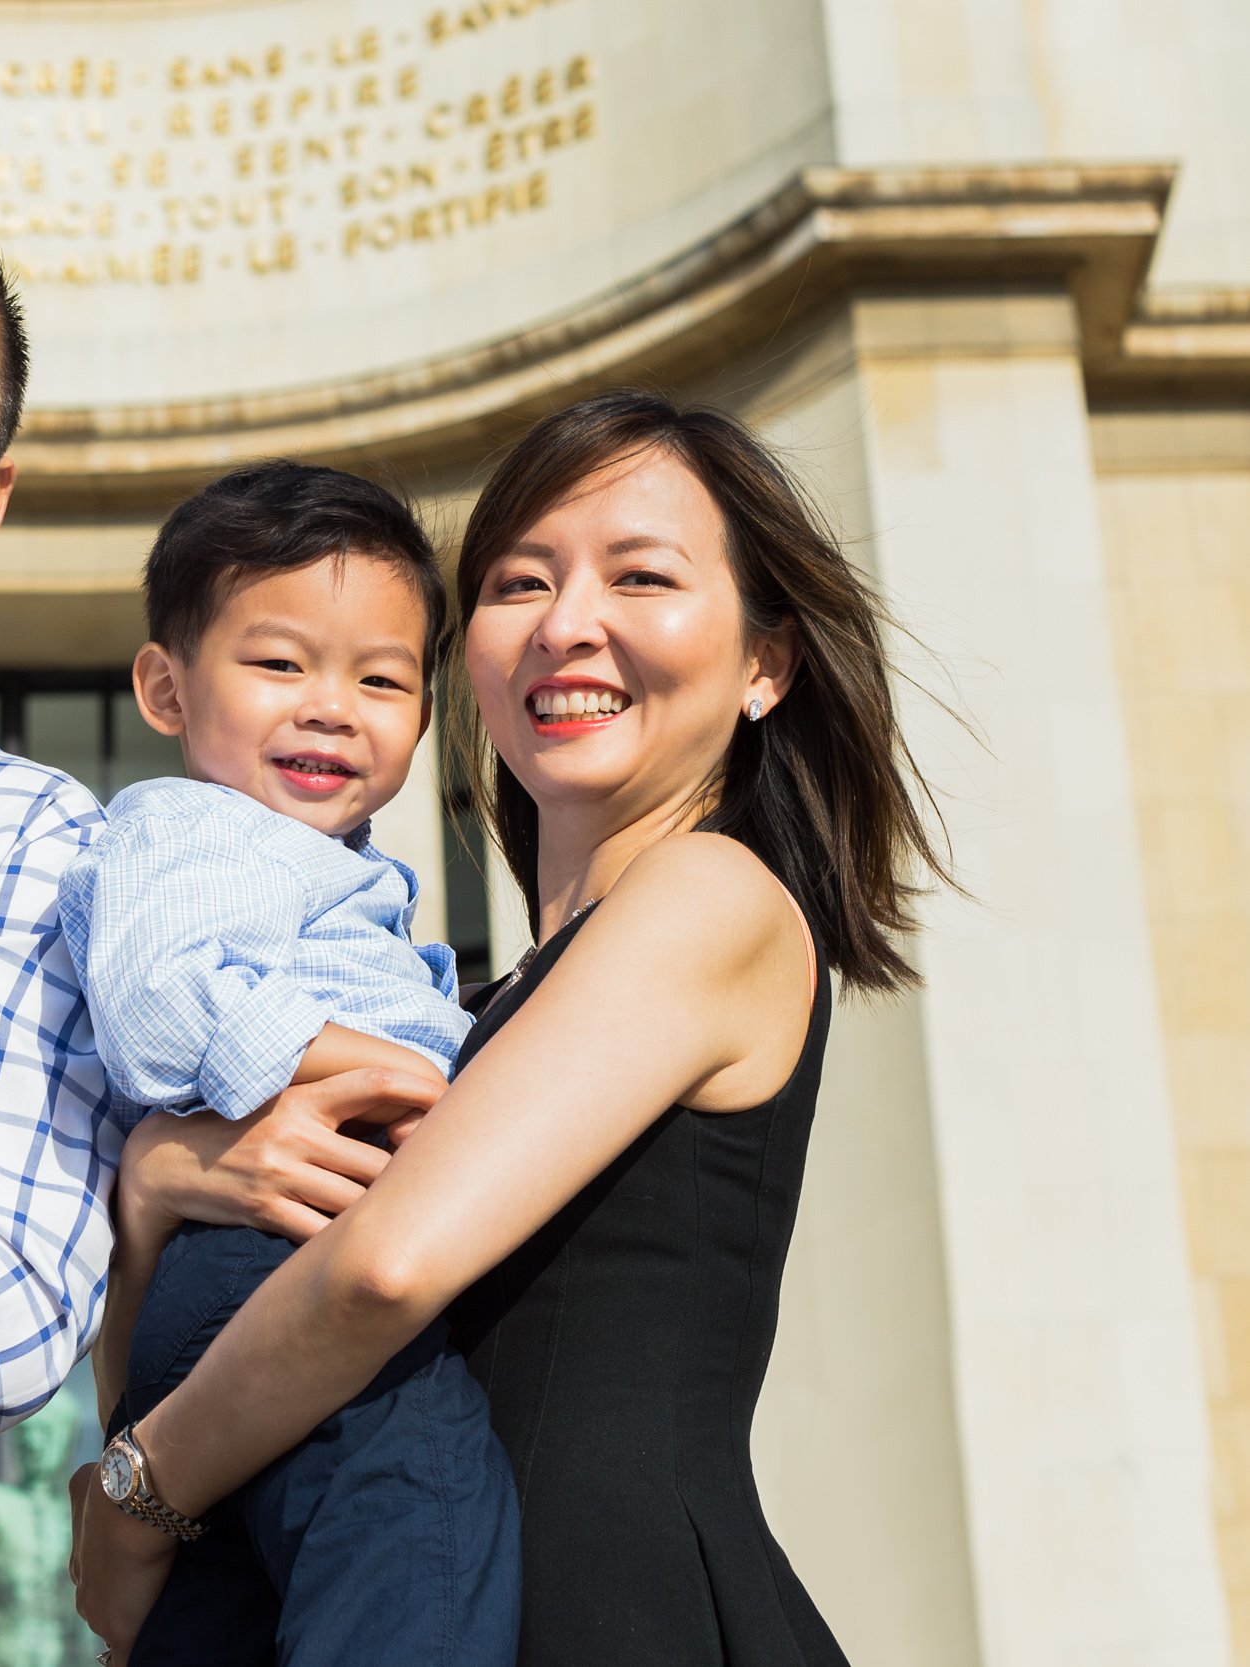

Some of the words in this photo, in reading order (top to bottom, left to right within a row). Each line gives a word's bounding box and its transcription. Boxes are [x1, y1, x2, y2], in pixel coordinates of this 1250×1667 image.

[327, 27, 383, 70] LE
[159, 184, 289, 236] TOUT
[339, 162, 440, 211] SON
